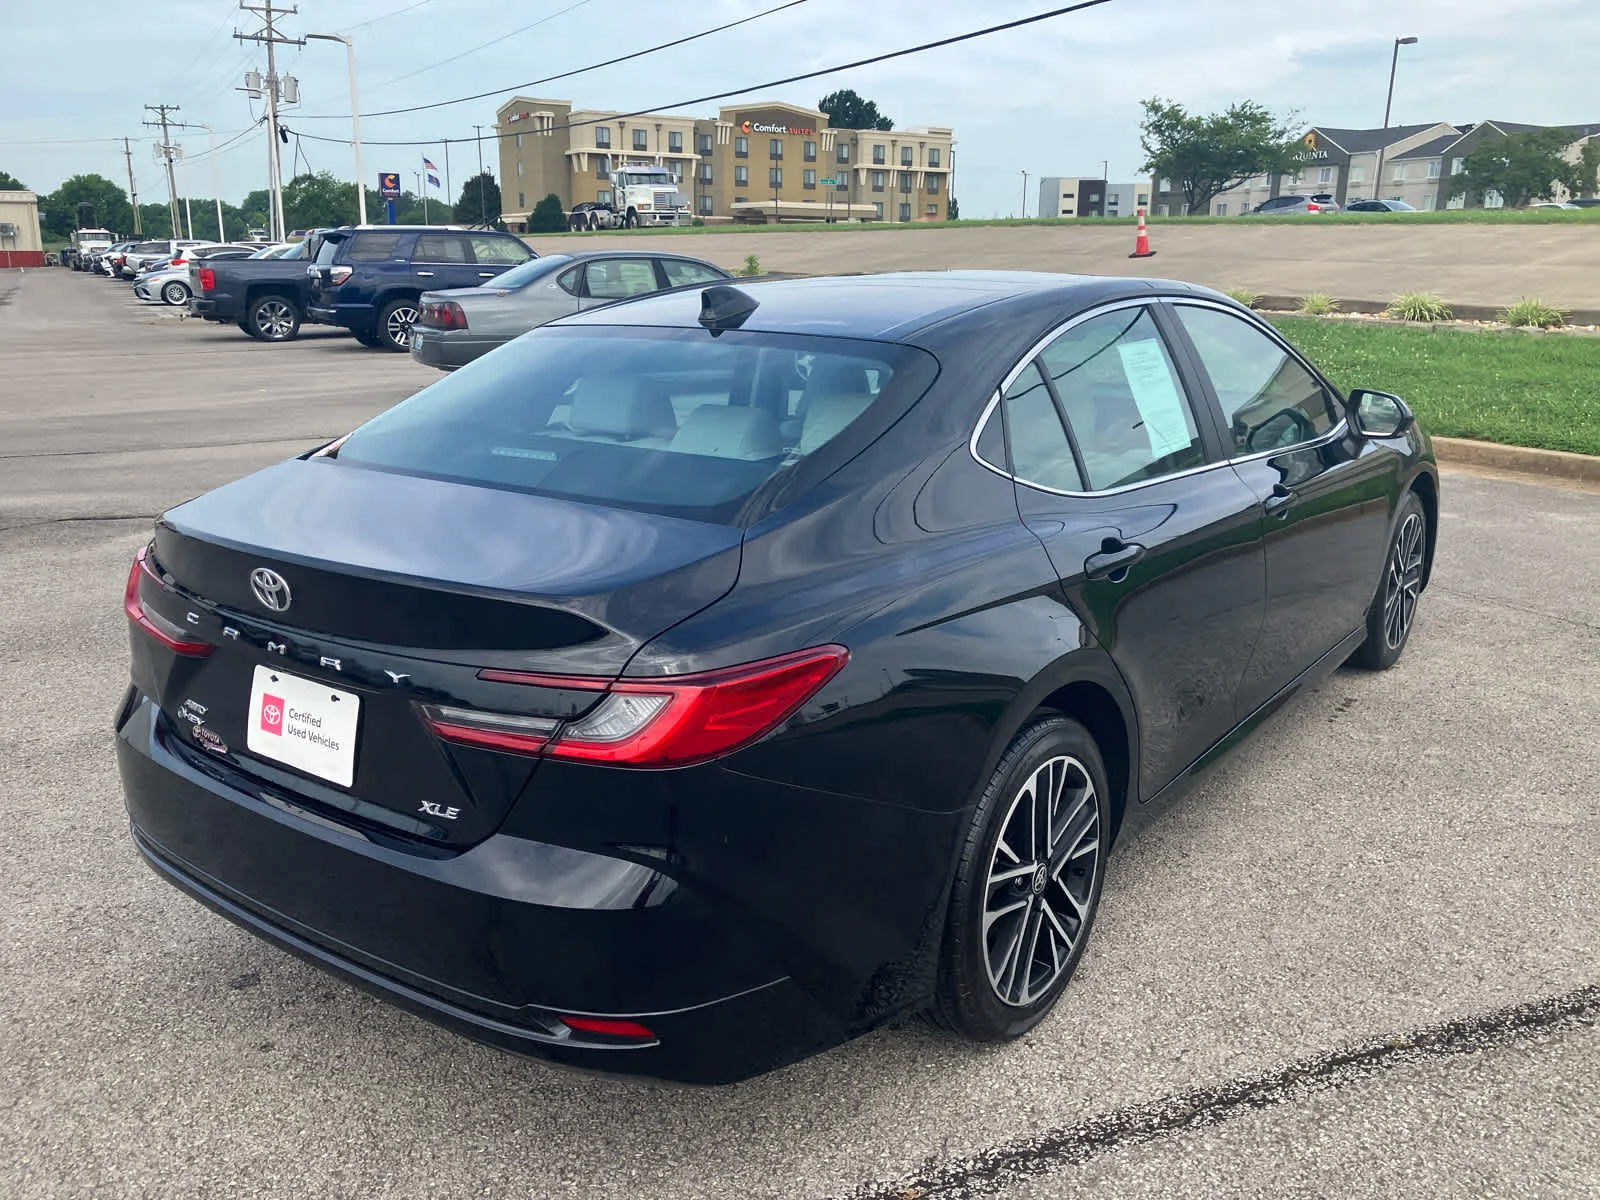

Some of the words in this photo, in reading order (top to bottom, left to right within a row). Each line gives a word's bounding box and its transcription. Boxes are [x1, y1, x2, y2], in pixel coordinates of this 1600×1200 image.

[753, 122, 787, 134] Comfort
[1295, 150, 1328, 161] QUINTA
[288, 707, 322, 728] Certified
[287, 723, 307, 740] Used
[308, 729, 340, 751] Vehicles
[416, 799, 460, 820] XLE
